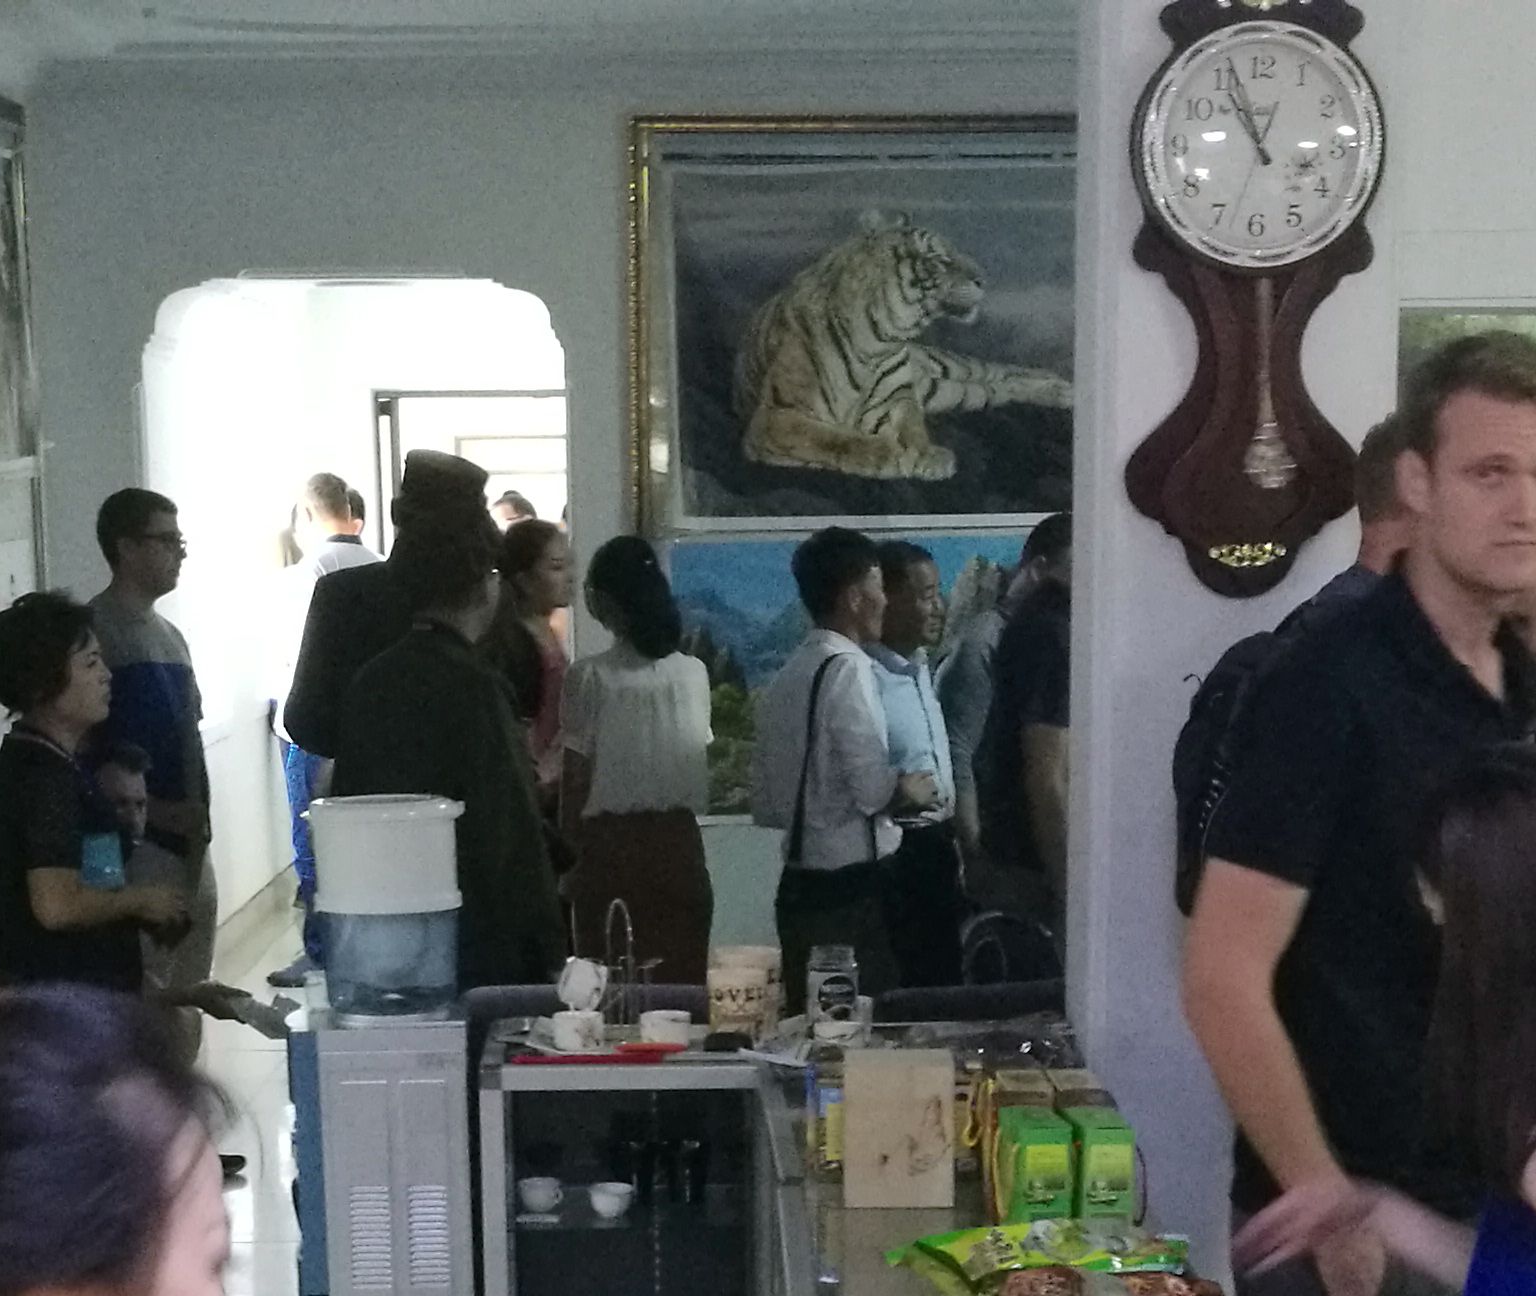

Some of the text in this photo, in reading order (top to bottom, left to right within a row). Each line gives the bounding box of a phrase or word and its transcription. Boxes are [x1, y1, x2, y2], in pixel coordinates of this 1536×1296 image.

[1250, 55, 1277, 80] 12
[1296, 60, 1312, 87] 1
[1185, 97, 1213, 121] 10
[1320, 94, 1336, 119] 2
[1170, 134, 1188, 157] 9
[1330, 135, 1346, 159] 3
[1183, 174, 1199, 198] 8
[1314, 176, 1330, 198] 4
[1211, 203, 1227, 226] 7
[1248, 213, 1265, 237] 6
[1286, 204, 1302, 227] 5
